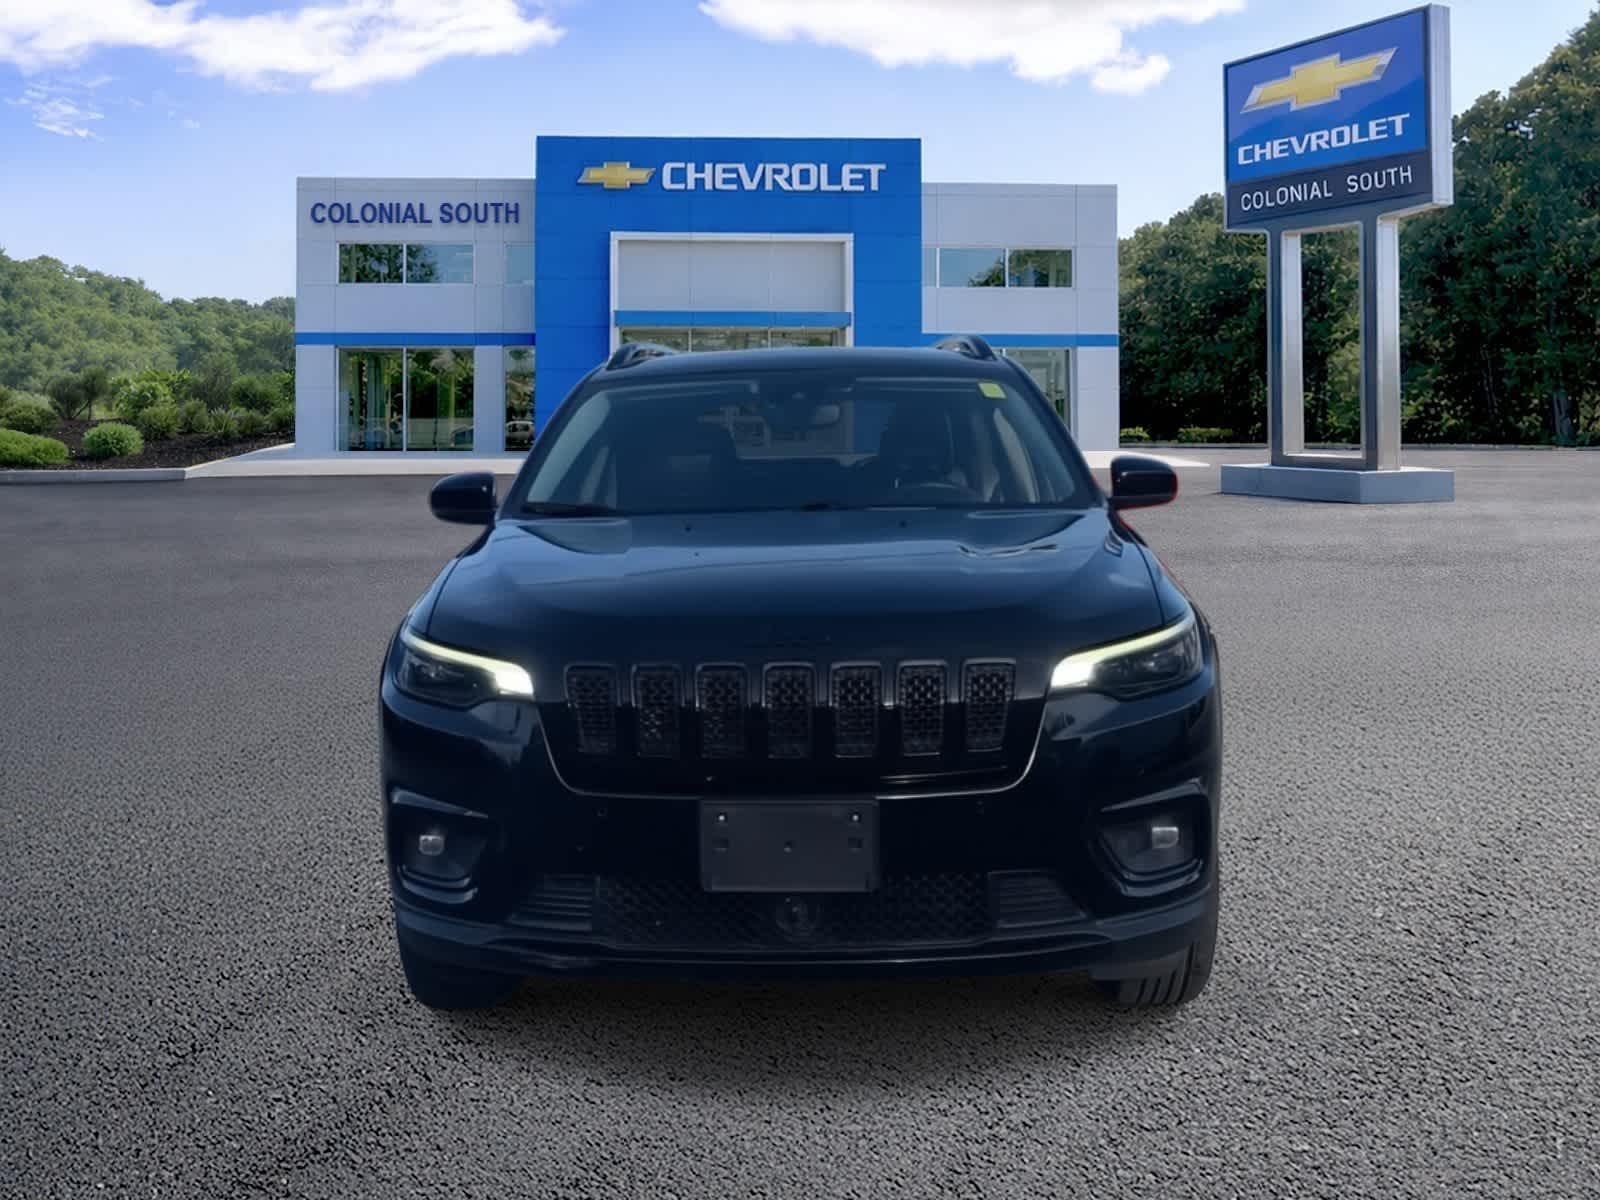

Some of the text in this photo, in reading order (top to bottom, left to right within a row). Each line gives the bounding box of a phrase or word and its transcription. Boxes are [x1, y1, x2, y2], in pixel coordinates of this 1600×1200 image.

[1238, 113, 1410, 165] CHEVROLET
[661, 161, 886, 191] CHEVROLET
[1241, 165, 1413, 211] COLONIAL SOUTH
[311, 202, 520, 225] COLONIAL SOUTH
